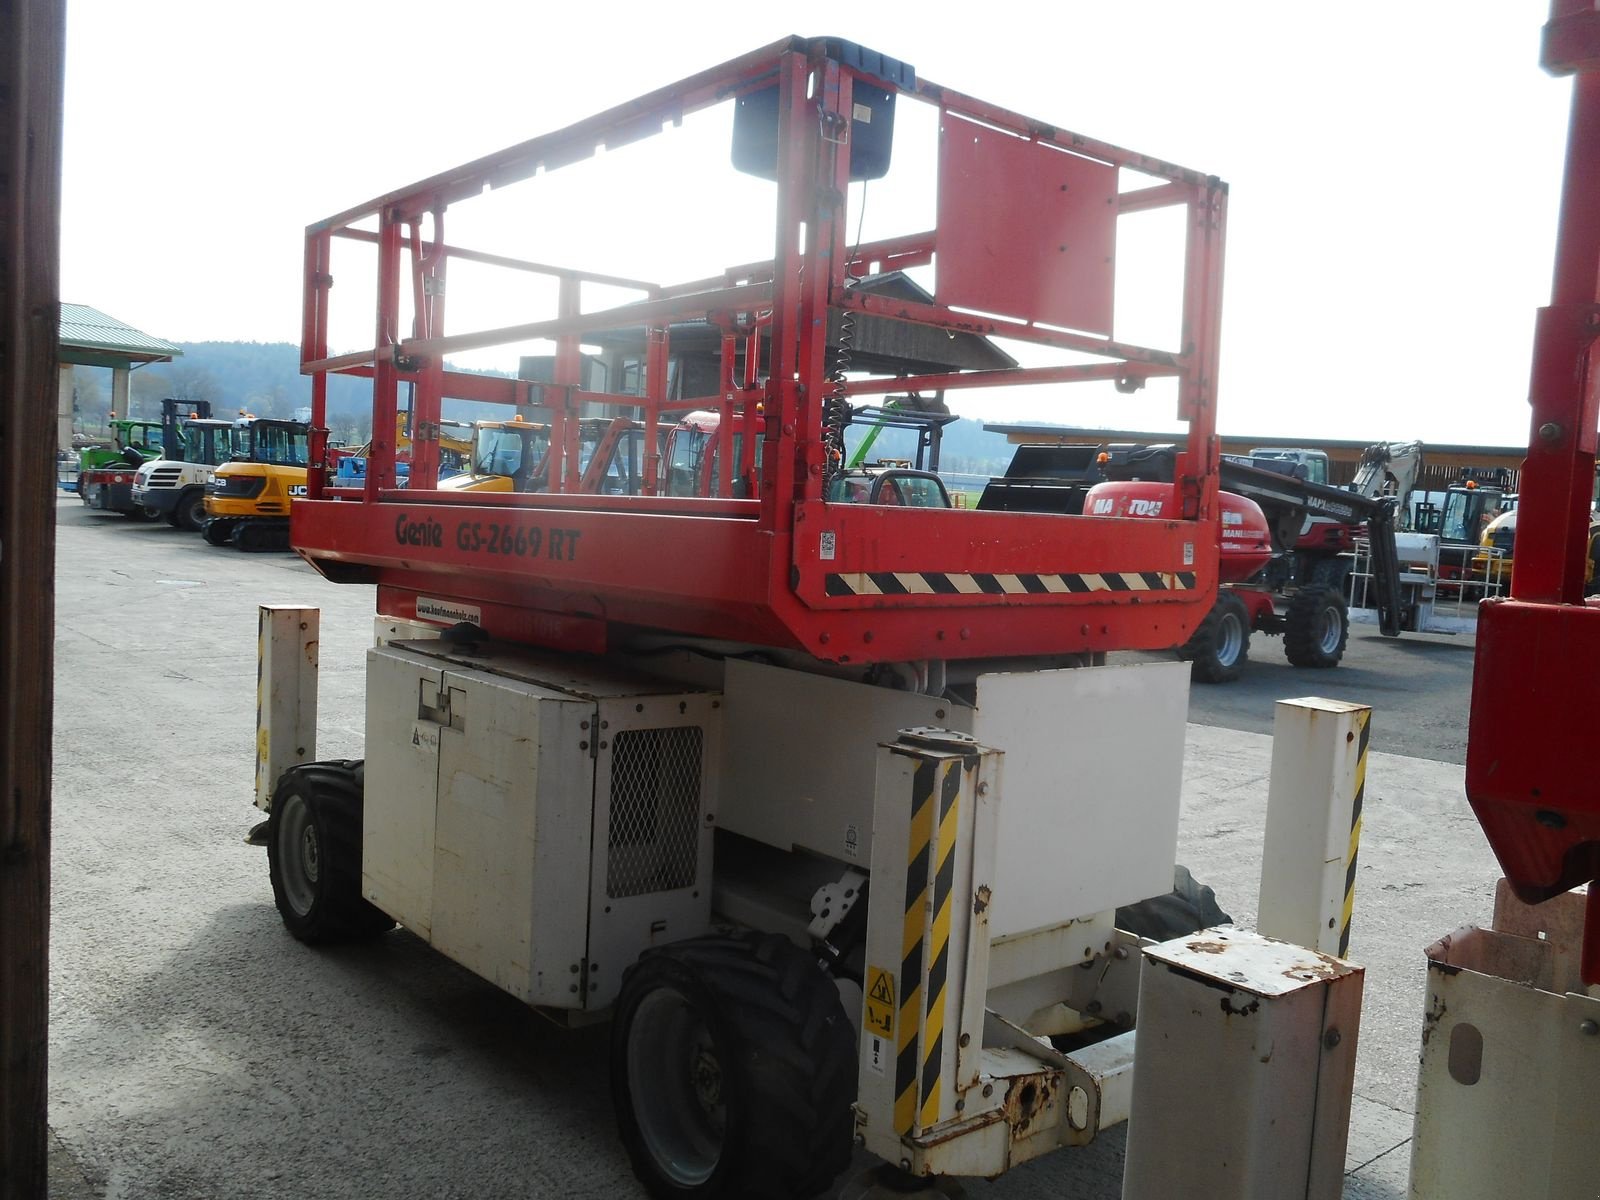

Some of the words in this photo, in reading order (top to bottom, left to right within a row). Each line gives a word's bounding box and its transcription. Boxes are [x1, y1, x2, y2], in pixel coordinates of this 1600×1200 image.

[288, 485, 308, 496] JC
[395, 513, 443, 548] Genie
[456, 520, 543, 558] GS-2669
[548, 527, 582, 561] RT
